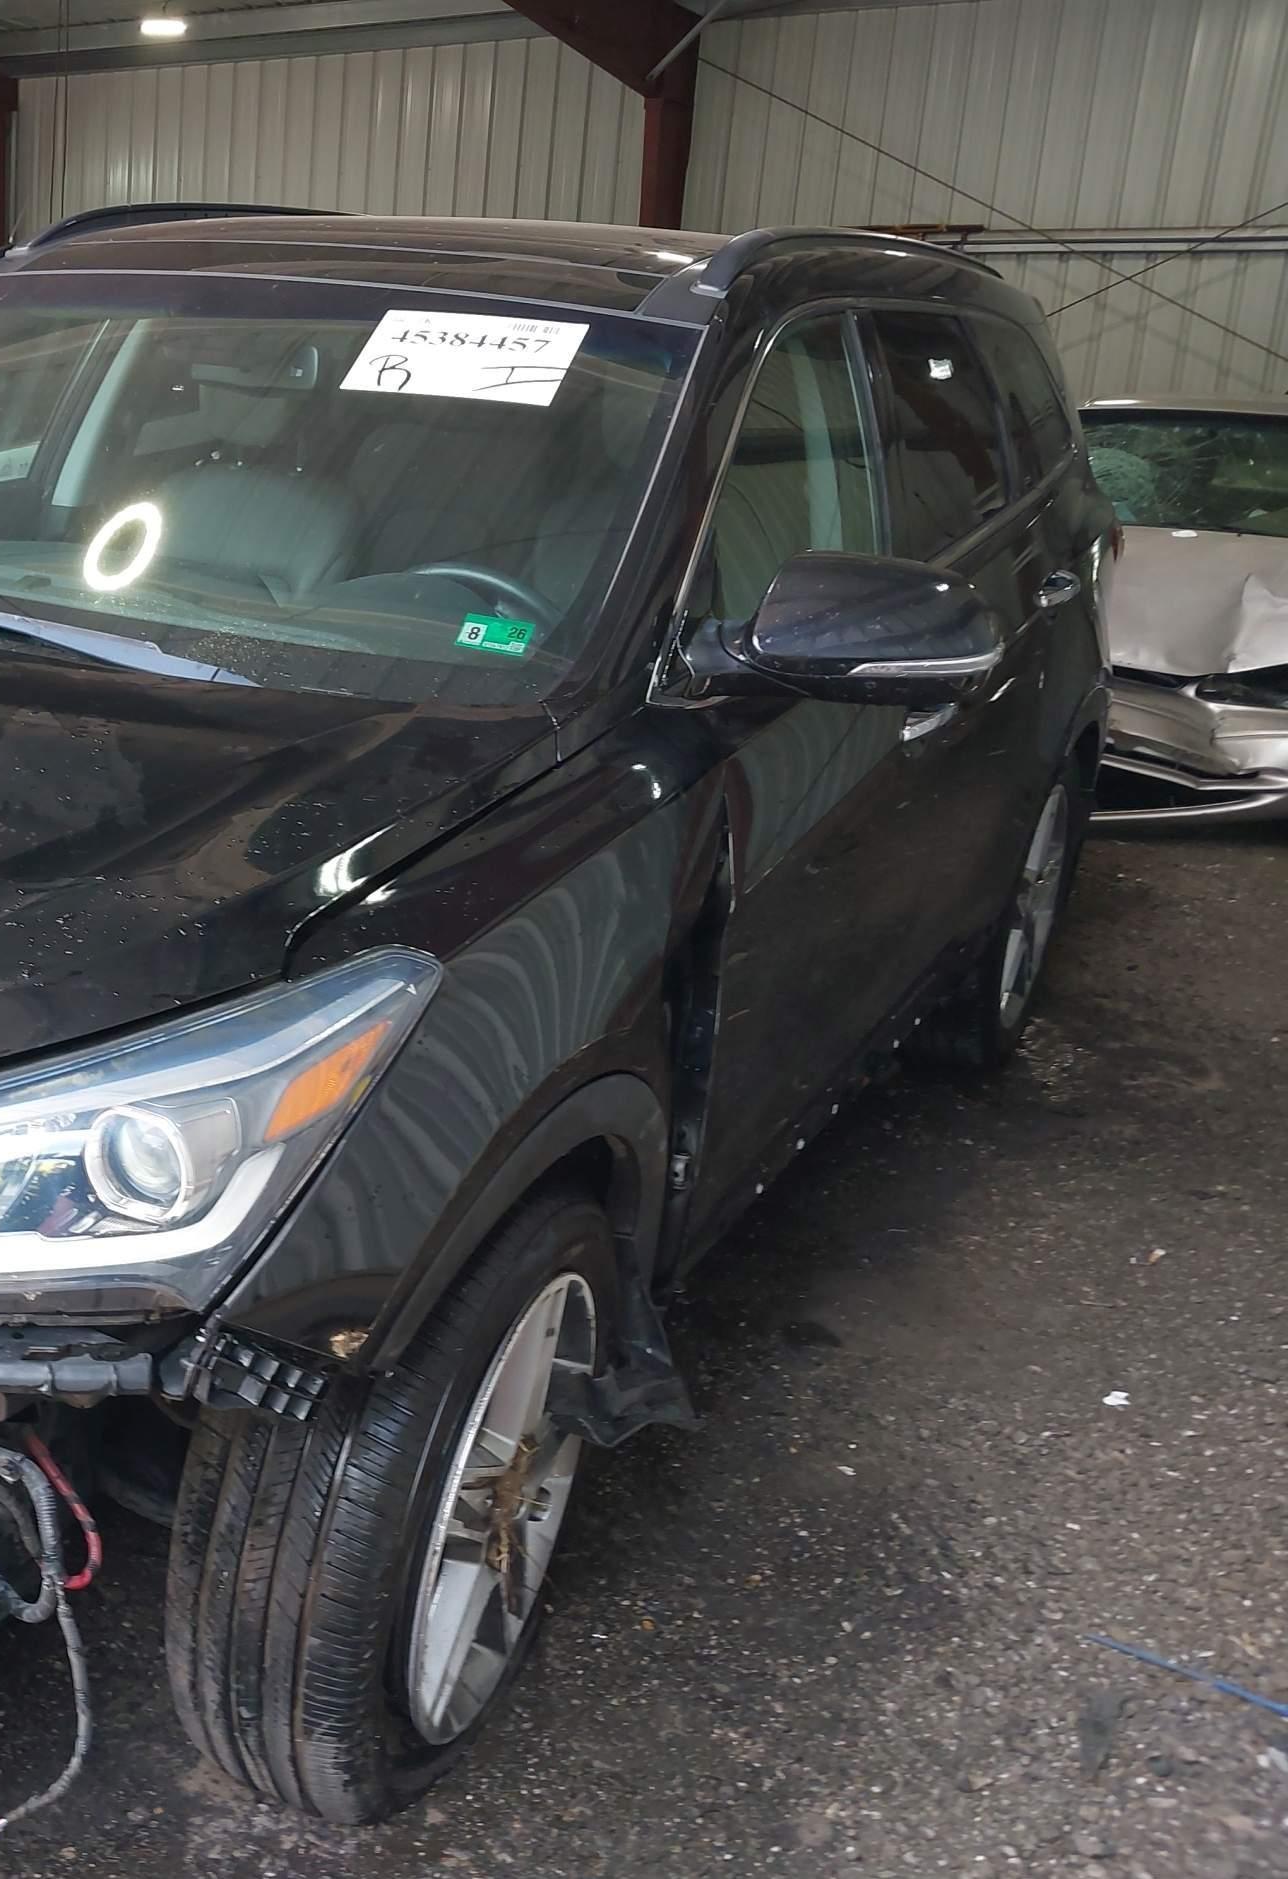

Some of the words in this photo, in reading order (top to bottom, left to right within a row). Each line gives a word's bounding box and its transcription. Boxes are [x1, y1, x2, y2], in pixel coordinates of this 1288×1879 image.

[391, 329, 552, 353] 45384457
[467, 626, 481, 640] 8
[507, 626, 528, 640] 26
